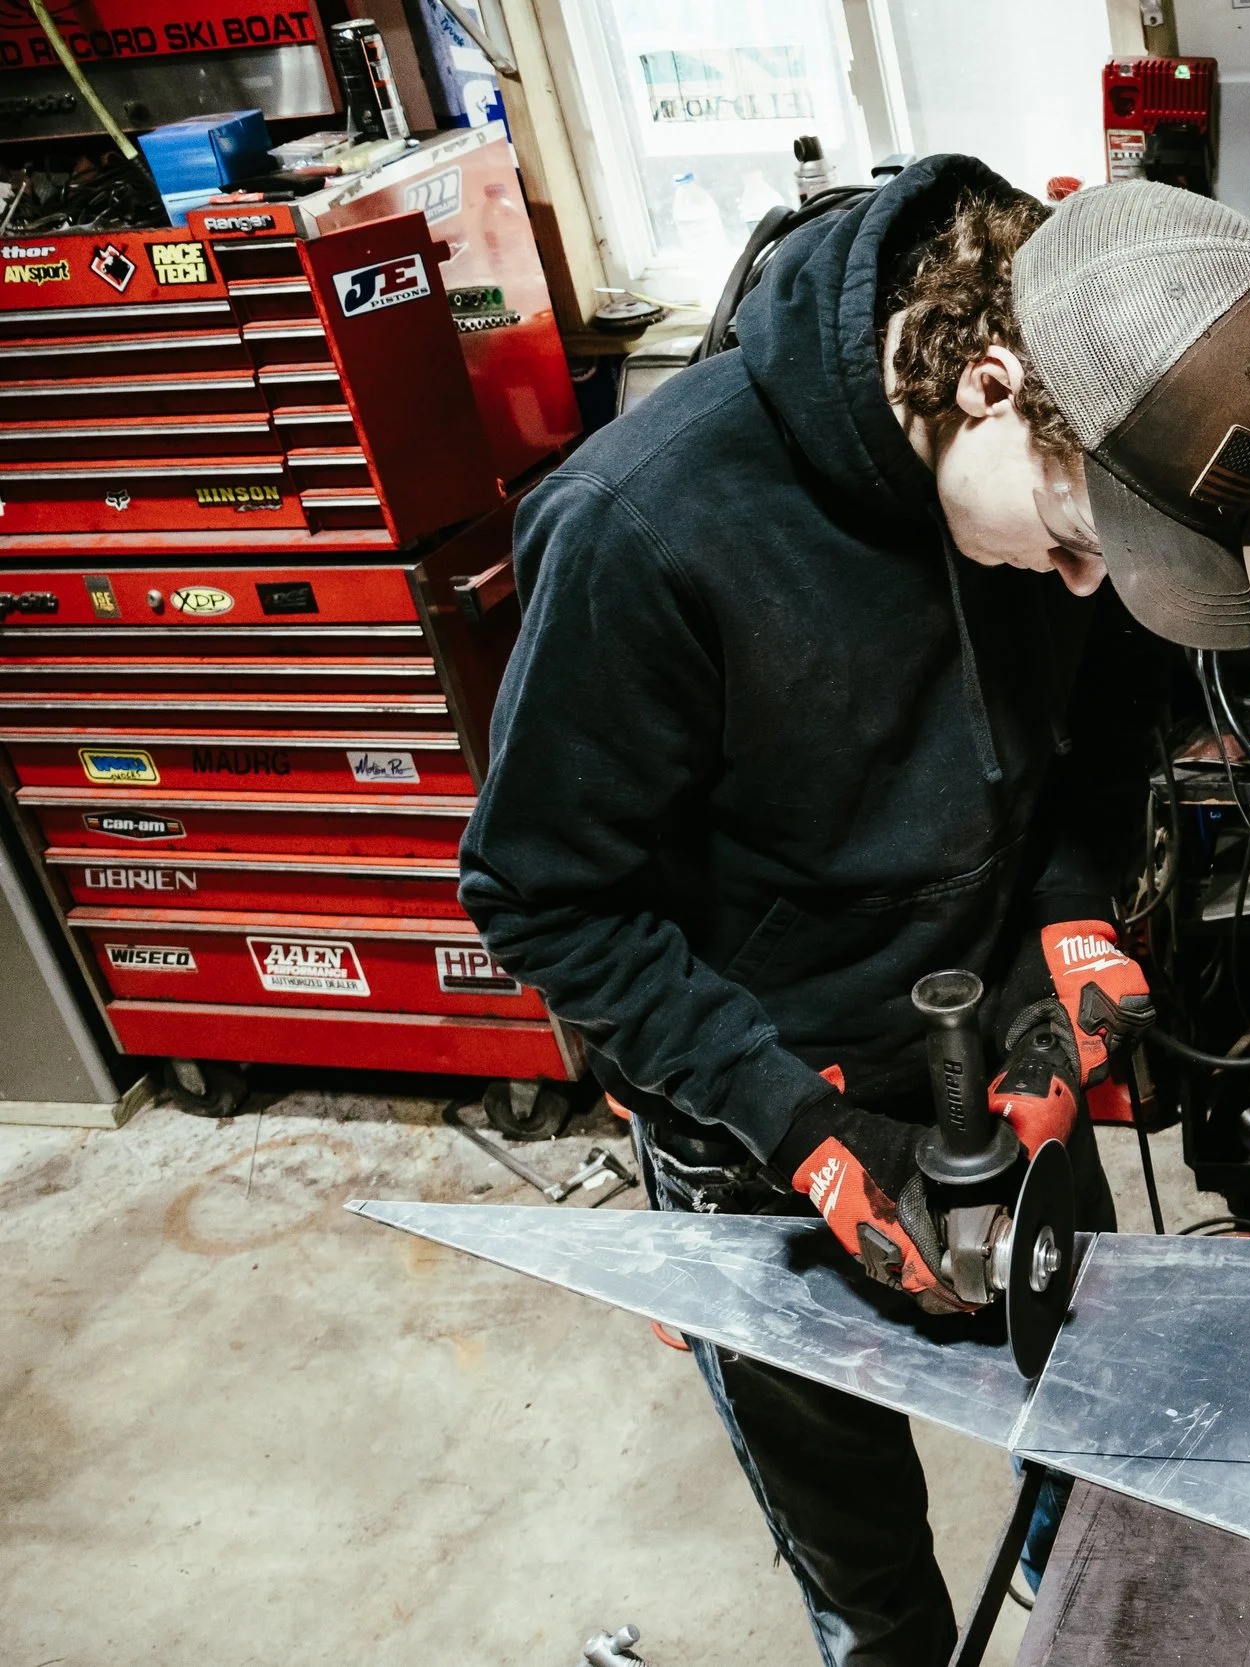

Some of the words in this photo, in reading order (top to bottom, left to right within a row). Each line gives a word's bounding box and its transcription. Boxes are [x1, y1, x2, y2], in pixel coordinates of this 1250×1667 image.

[28, 26, 158, 63] RCORD
[163, 20, 219, 50] SKI
[223, 11, 310, 45] BOAT
[203, 215, 274, 232] Ranger
[2, 244, 57, 259] thor
[152, 243, 204, 266] RACE
[155, 263, 208, 285] TECH
[343, 257, 420, 314] JE
[370, 286, 430, 309] PISTONS
[174, 590, 226, 612] XDP
[355, 753, 387, 776] Motion
[102, 818, 166, 832] can-am
[111, 948, 190, 967] WISECO
[263, 944, 345, 969] AAEN
[266, 964, 348, 980] PERFORMANCE
[271, 977, 323, 988] AUTHORIZED
[325, 978, 359, 990] DEALER
